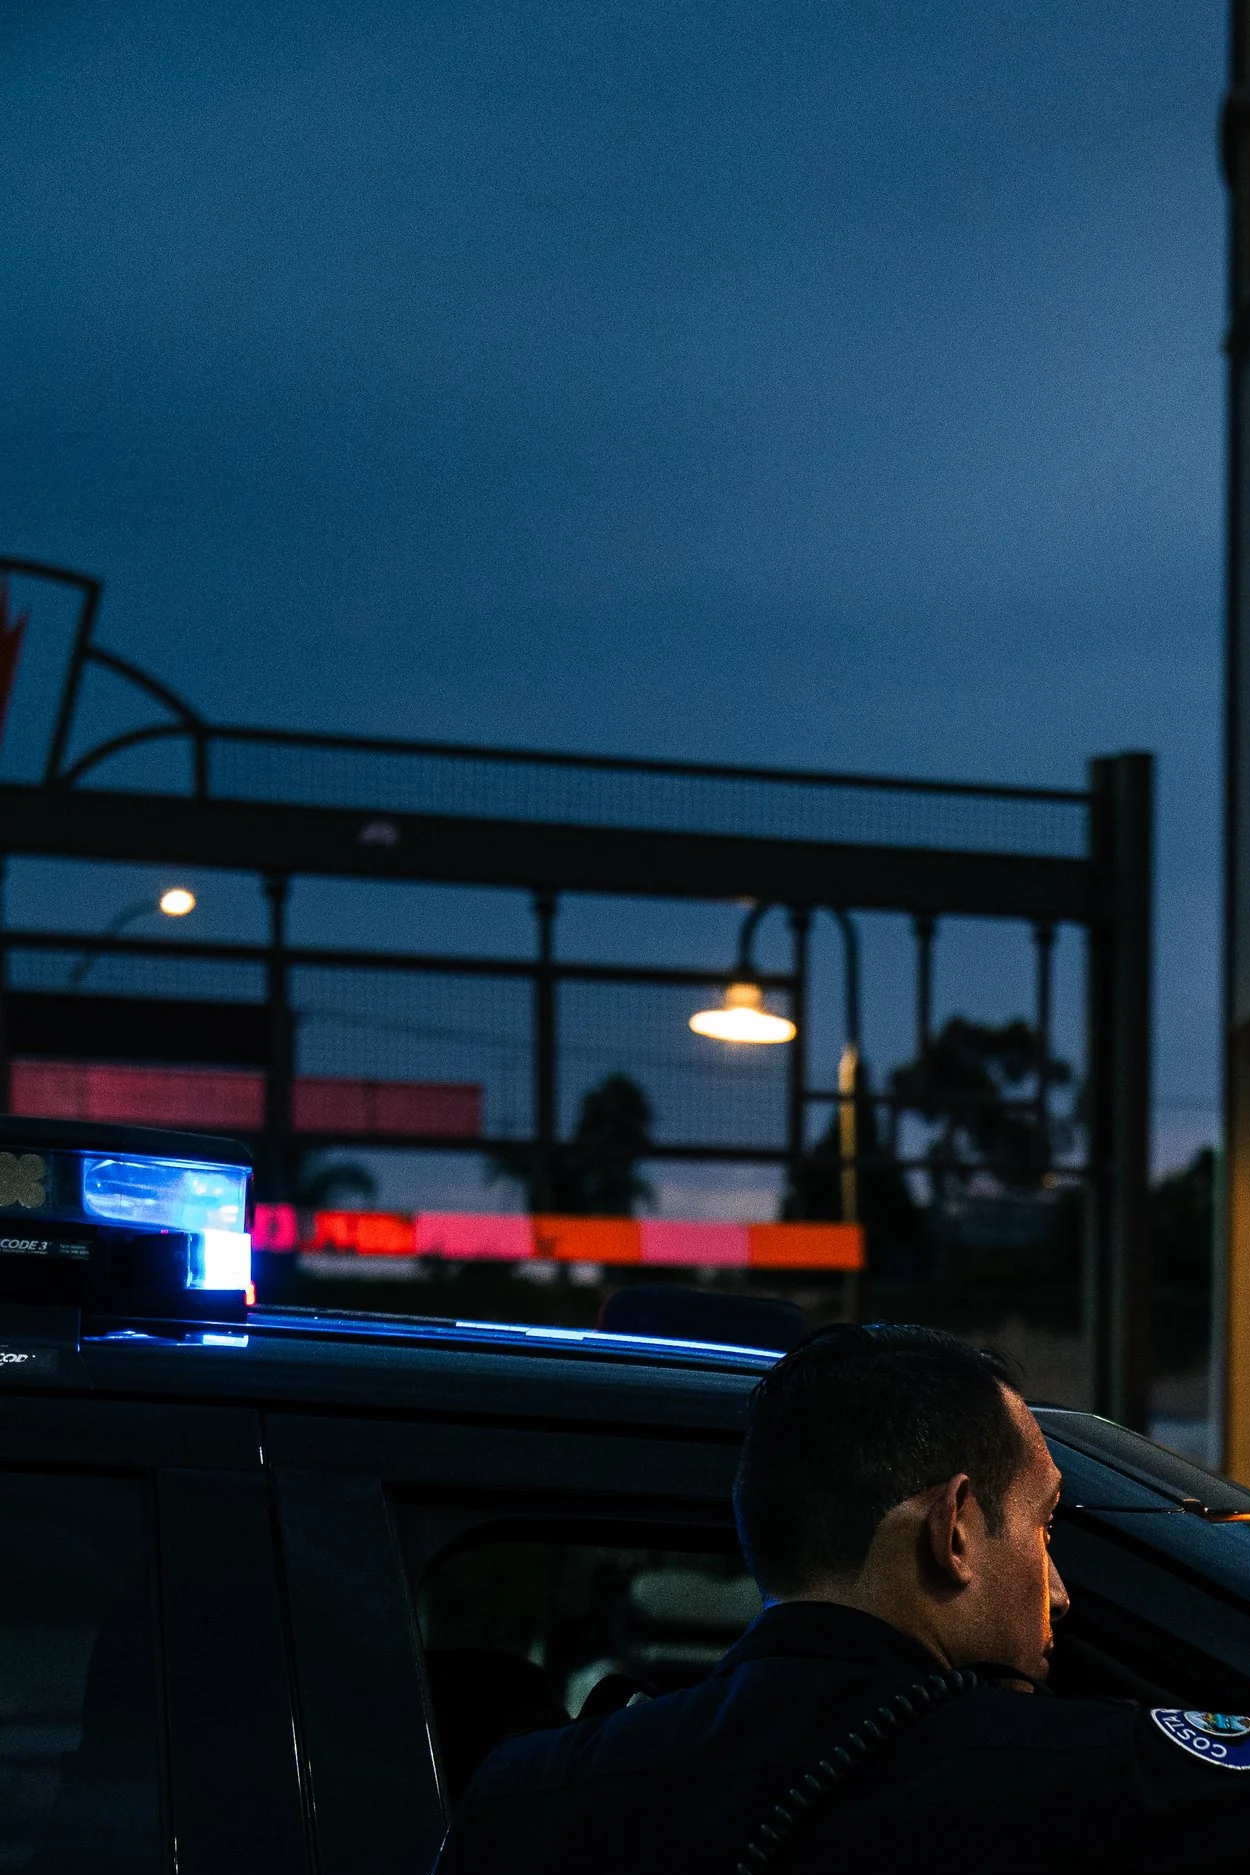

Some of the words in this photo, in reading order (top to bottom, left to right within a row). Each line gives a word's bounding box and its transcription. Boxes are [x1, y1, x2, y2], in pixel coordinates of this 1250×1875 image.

[0, 1238, 39, 1251] CODE
[38, 1241, 48, 1251] 3
[1163, 1715, 1227, 1758] COSTA
